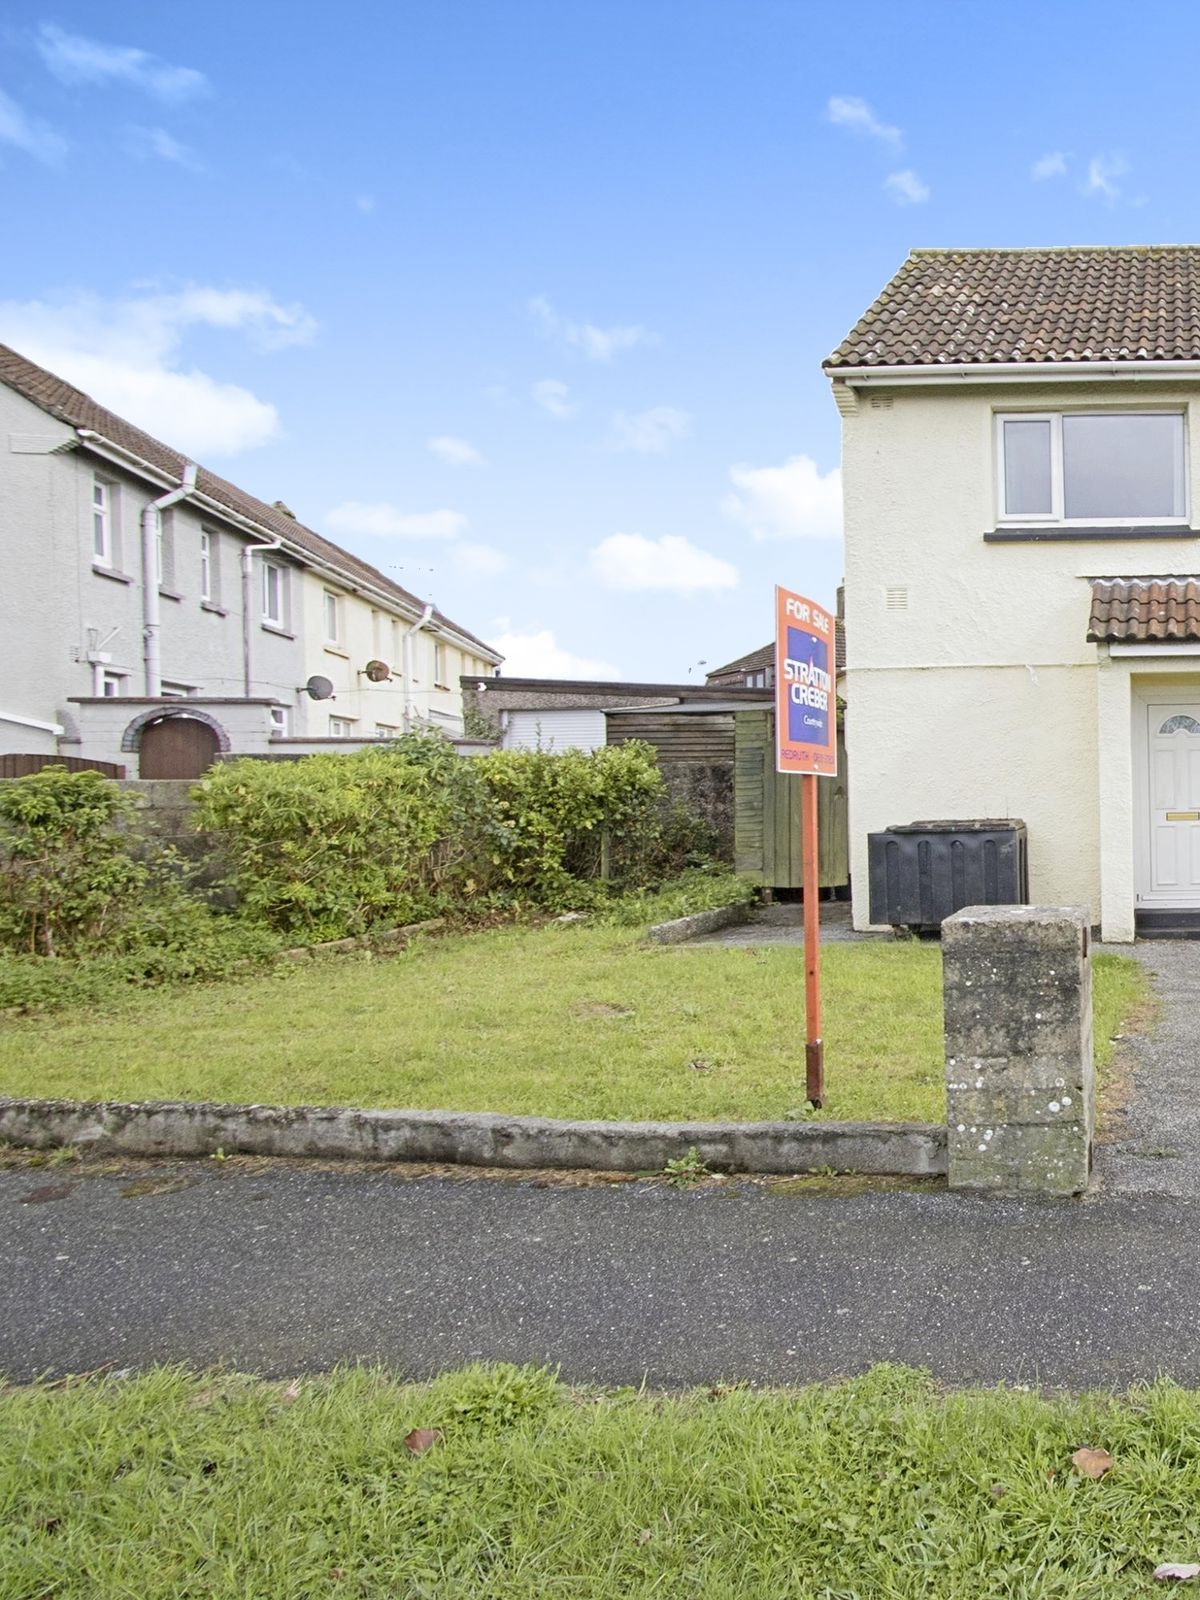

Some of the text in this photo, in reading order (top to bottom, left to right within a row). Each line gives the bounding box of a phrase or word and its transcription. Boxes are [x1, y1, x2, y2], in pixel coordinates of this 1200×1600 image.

[786, 598, 829, 634] FOR SALE
[784, 657, 831, 692] STRATTON
[792, 683, 828, 711] CREBER
